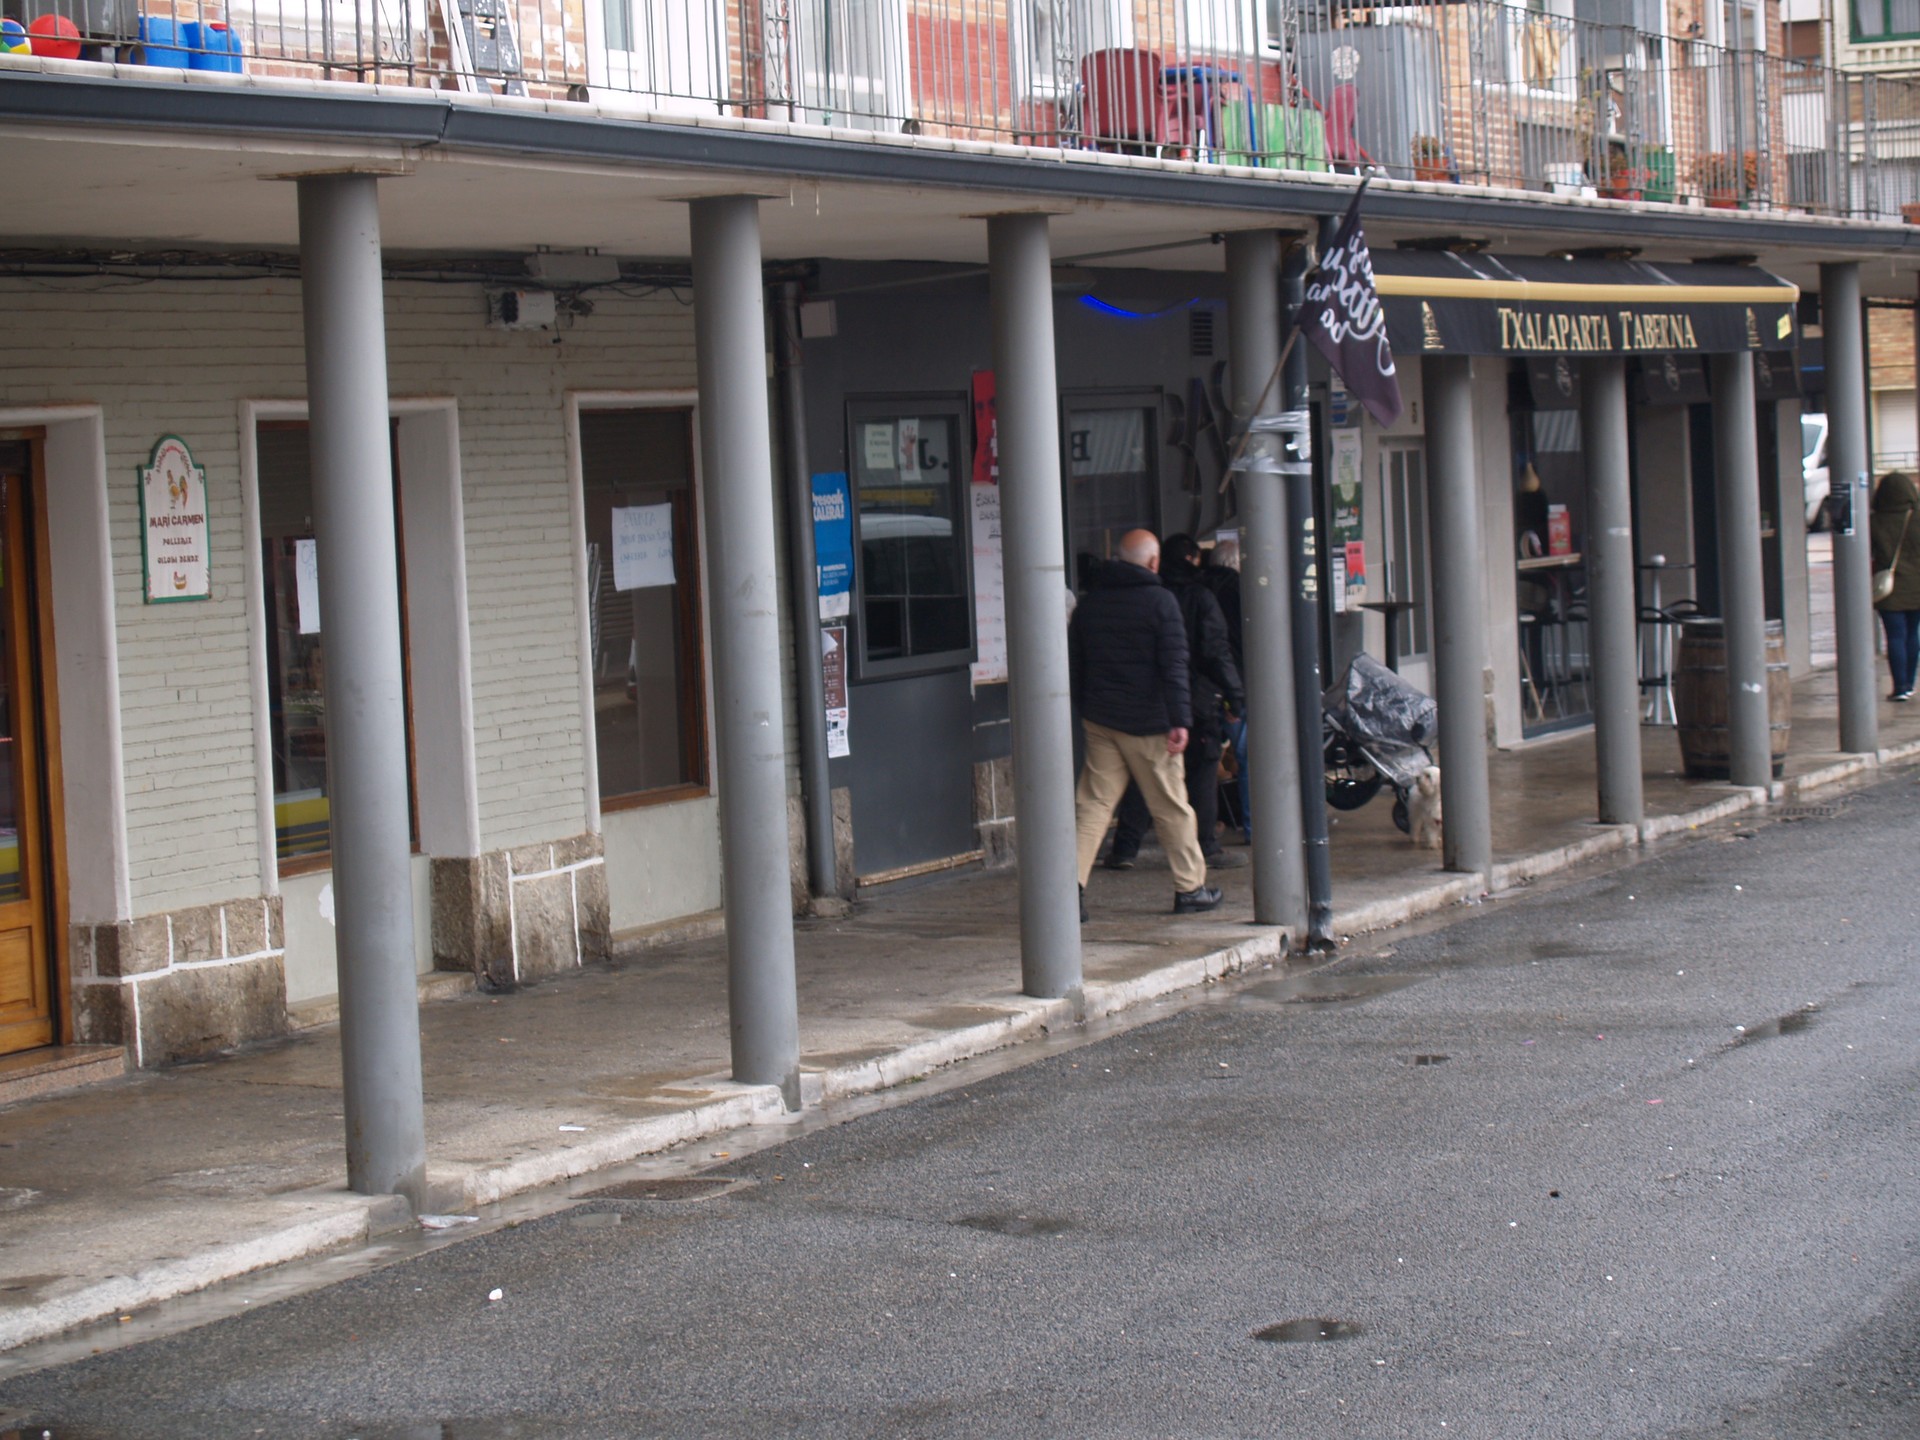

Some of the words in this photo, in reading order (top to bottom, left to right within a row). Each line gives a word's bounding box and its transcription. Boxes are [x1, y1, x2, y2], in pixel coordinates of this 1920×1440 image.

[1498, 307, 1612, 350] TXALAPARTA
[1619, 311, 1698, 349] TABERNA
[812, 488, 844, 507] resoak
[149, 514, 171, 528] MARI
[171, 514, 204, 526] CARMEN
